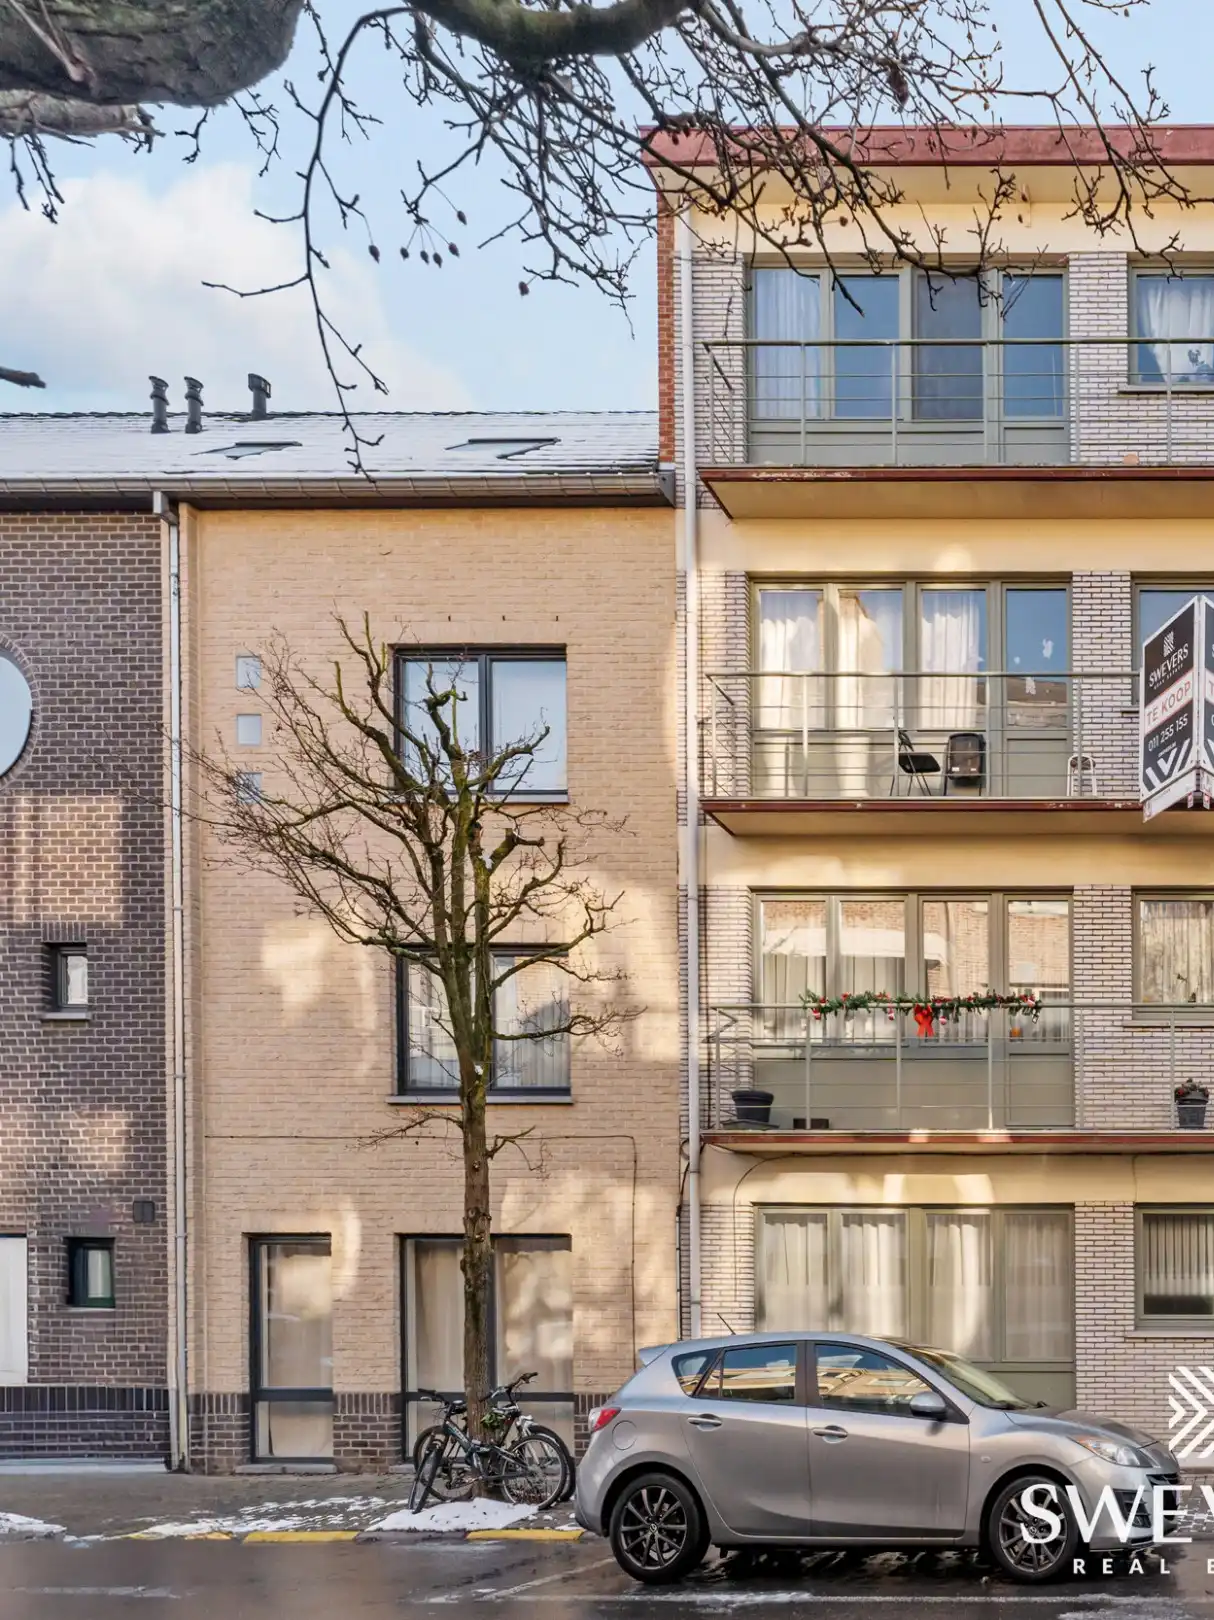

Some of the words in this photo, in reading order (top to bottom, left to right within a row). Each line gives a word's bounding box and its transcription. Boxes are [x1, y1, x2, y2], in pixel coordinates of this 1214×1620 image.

[1149, 643, 1189, 688] SWEVERS
[1147, 706, 1159, 723] TE
[1161, 681, 1191, 714] KOOP
[1148, 732, 1159, 752] 011
[1160, 723, 1174, 743] 255
[1175, 713, 1188, 732] 155
